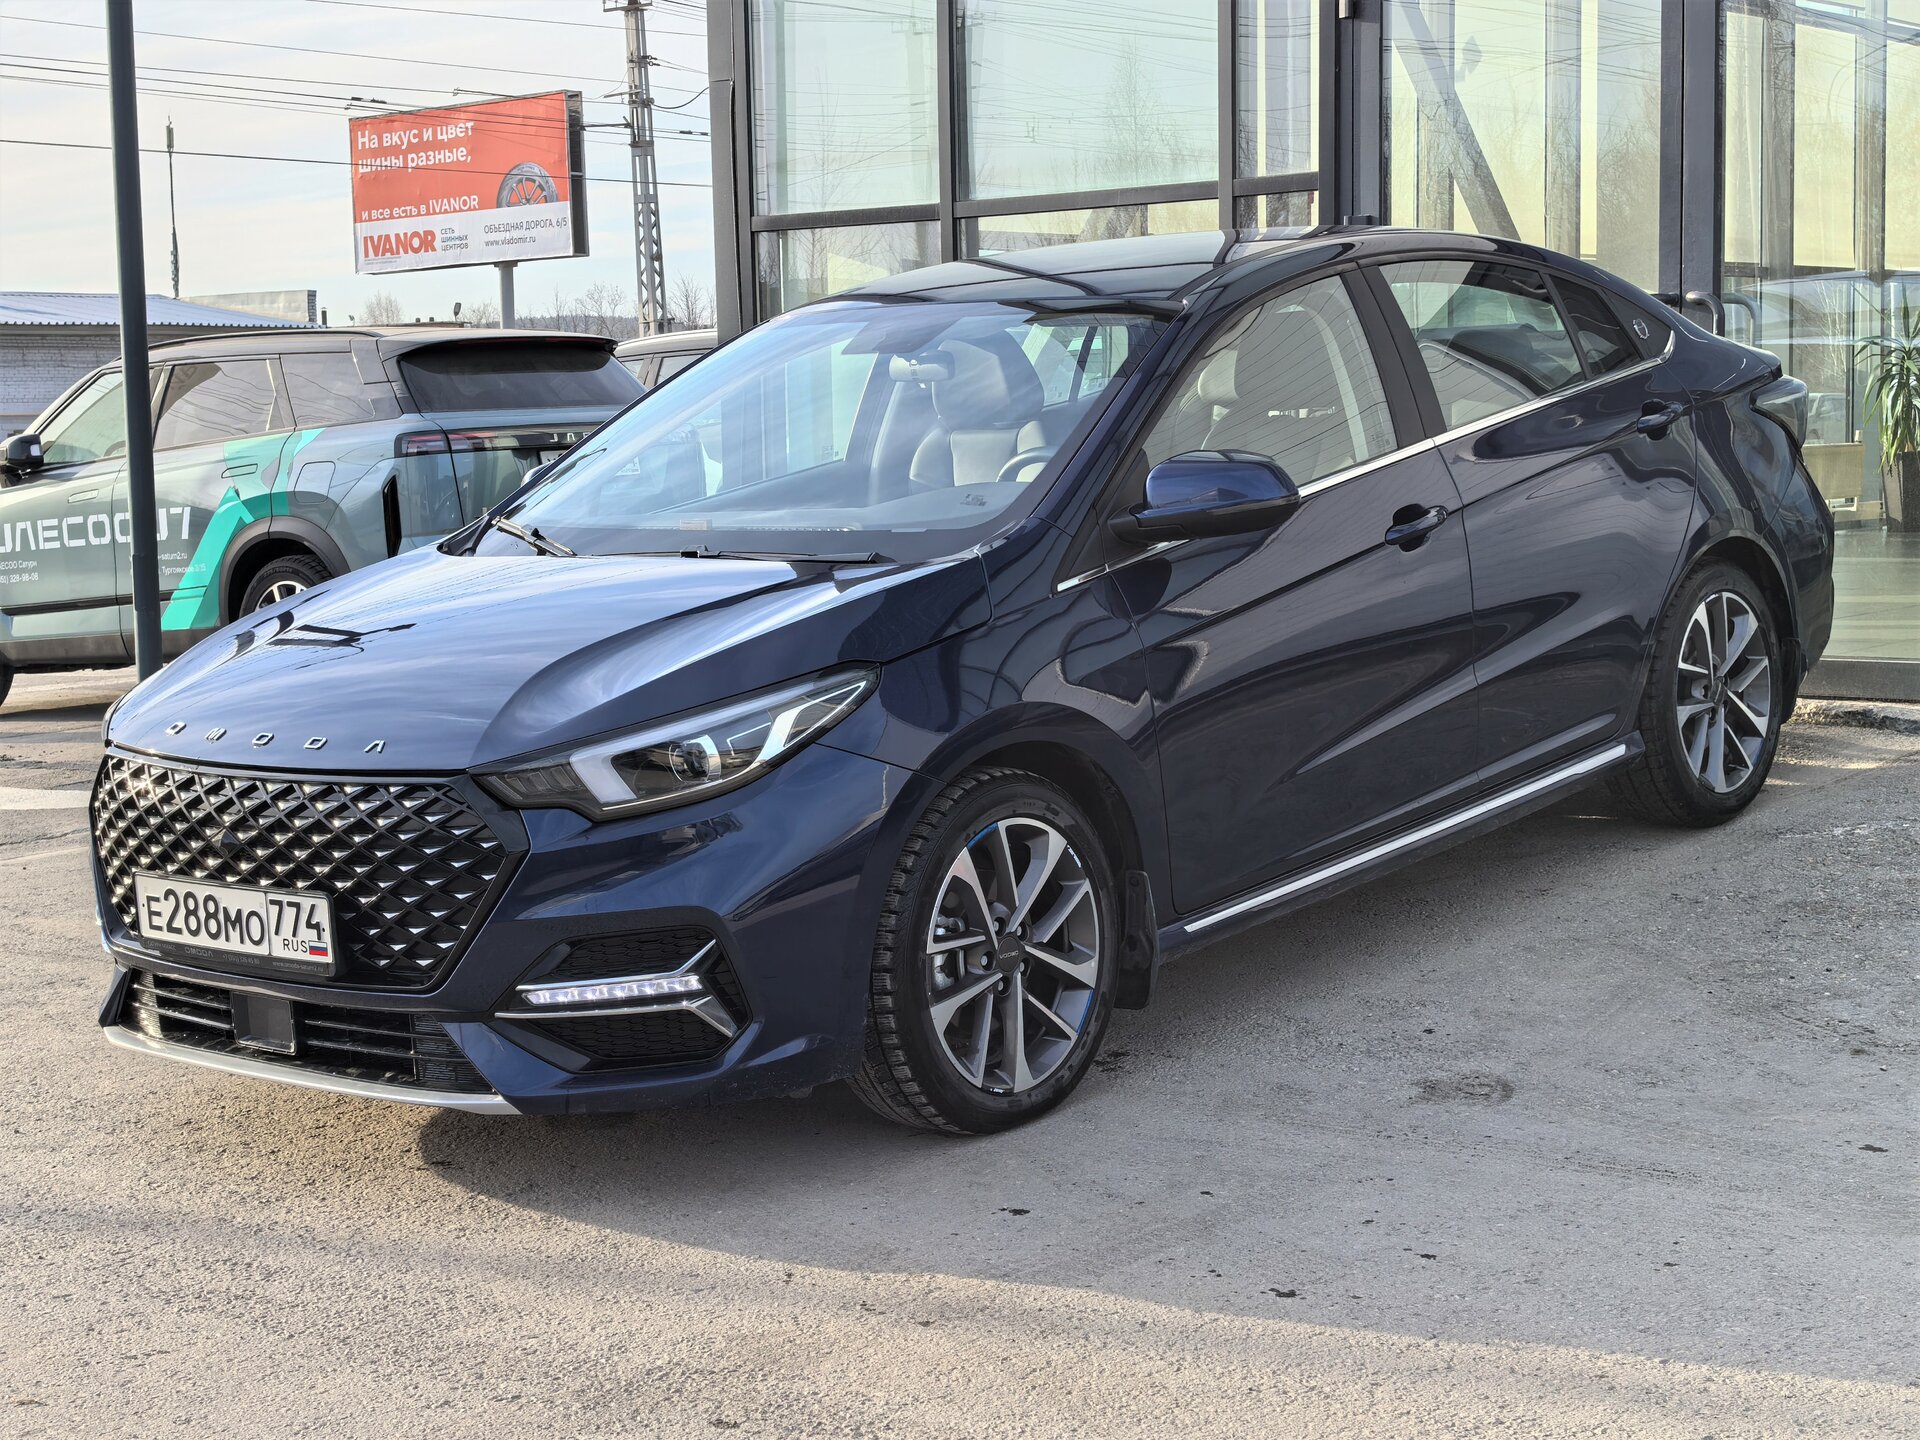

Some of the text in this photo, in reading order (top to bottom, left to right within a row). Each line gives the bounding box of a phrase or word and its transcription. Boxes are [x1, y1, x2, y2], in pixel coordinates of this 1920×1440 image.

[357, 121, 474, 150] На вкус и цвет
[358, 146, 472, 173] шины разные,
[361, 195, 479, 221] и все есть в IVANOR
[440, 227, 456, 236] СЕТЬ
[483, 221, 524, 234] ОБЪЕЗДНАЯ
[555, 216, 568, 229] 6/5
[363, 229, 437, 258] IVANOR
[440, 234, 469, 244] ШИННЫХ
[441, 242, 469, 252] ЦЕНТРОВ
[484, 235, 537, 247] www.vladomir.ru
[164, 721, 386, 754] OMODA
[269, 900, 323, 940] 774
[282, 938, 308, 953] RUS
